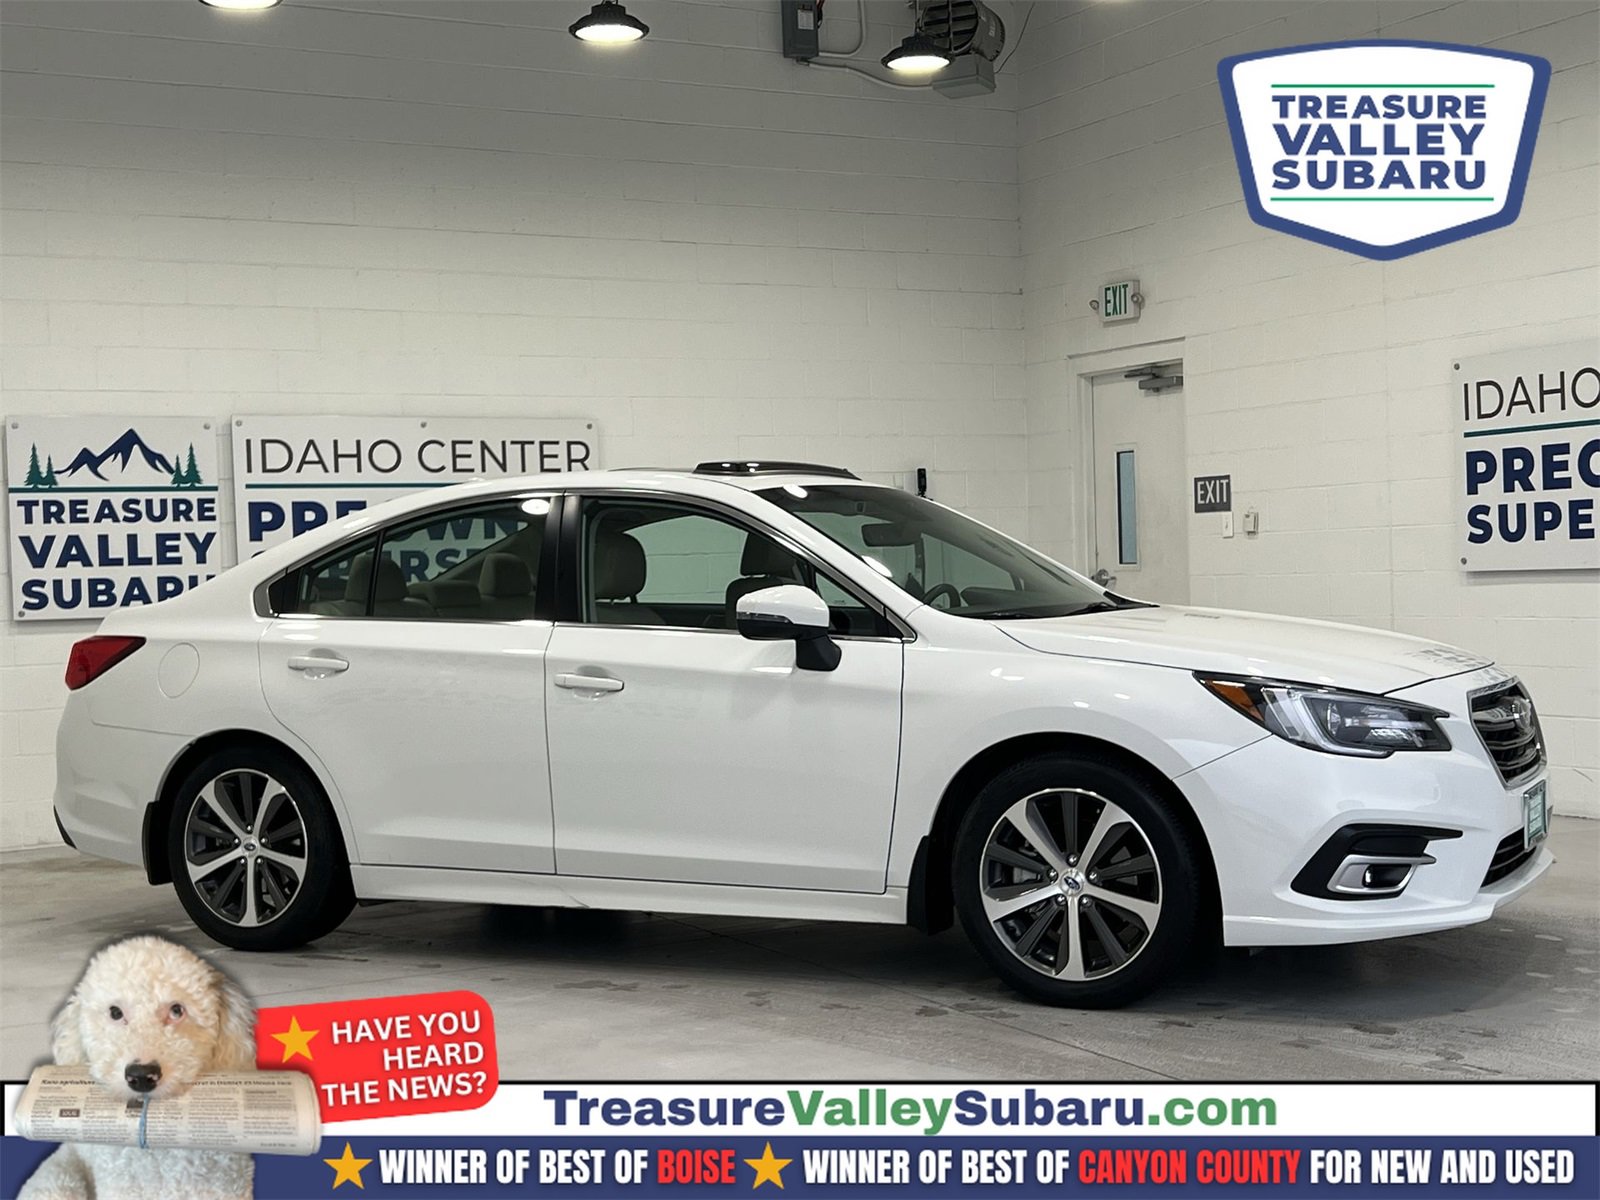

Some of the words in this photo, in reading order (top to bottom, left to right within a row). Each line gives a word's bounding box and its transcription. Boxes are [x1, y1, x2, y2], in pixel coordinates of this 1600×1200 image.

[1104, 284, 1129, 317] EXIT
[245, 438, 402, 474] IDAHO
[417, 439, 591, 474] CENTER
[1196, 478, 1230, 505] EXIT
[16, 497, 217, 525] TREASURE
[1467, 498, 1596, 545] SUPE
[18, 531, 217, 569] VALLEY
